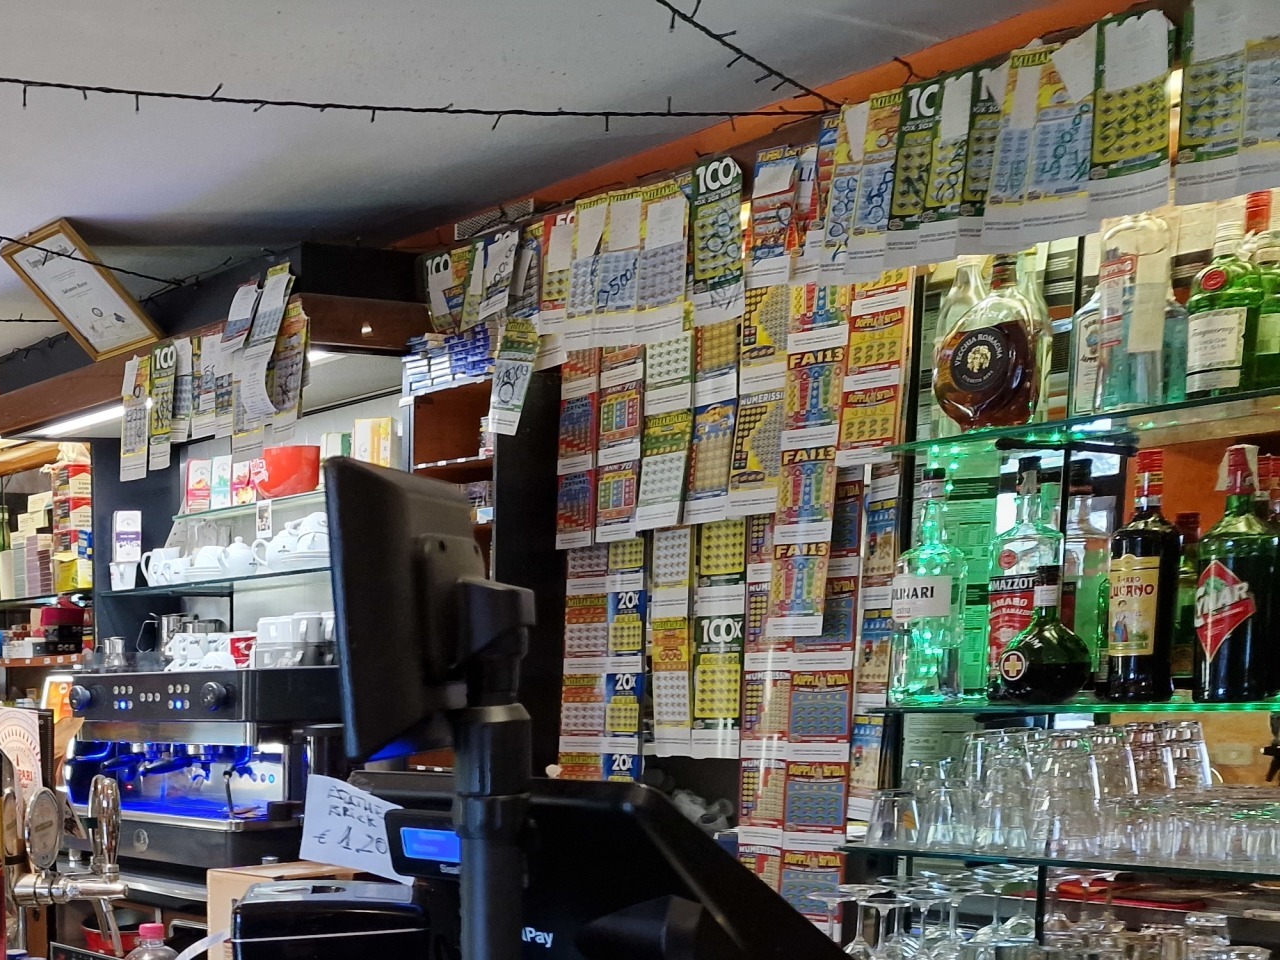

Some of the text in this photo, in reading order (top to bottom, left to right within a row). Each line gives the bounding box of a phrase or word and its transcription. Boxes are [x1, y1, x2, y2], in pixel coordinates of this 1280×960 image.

[954, 333, 1003, 367] VECCHIA ROMAGNA
[1110, 583, 1155, 599] LUCANO
